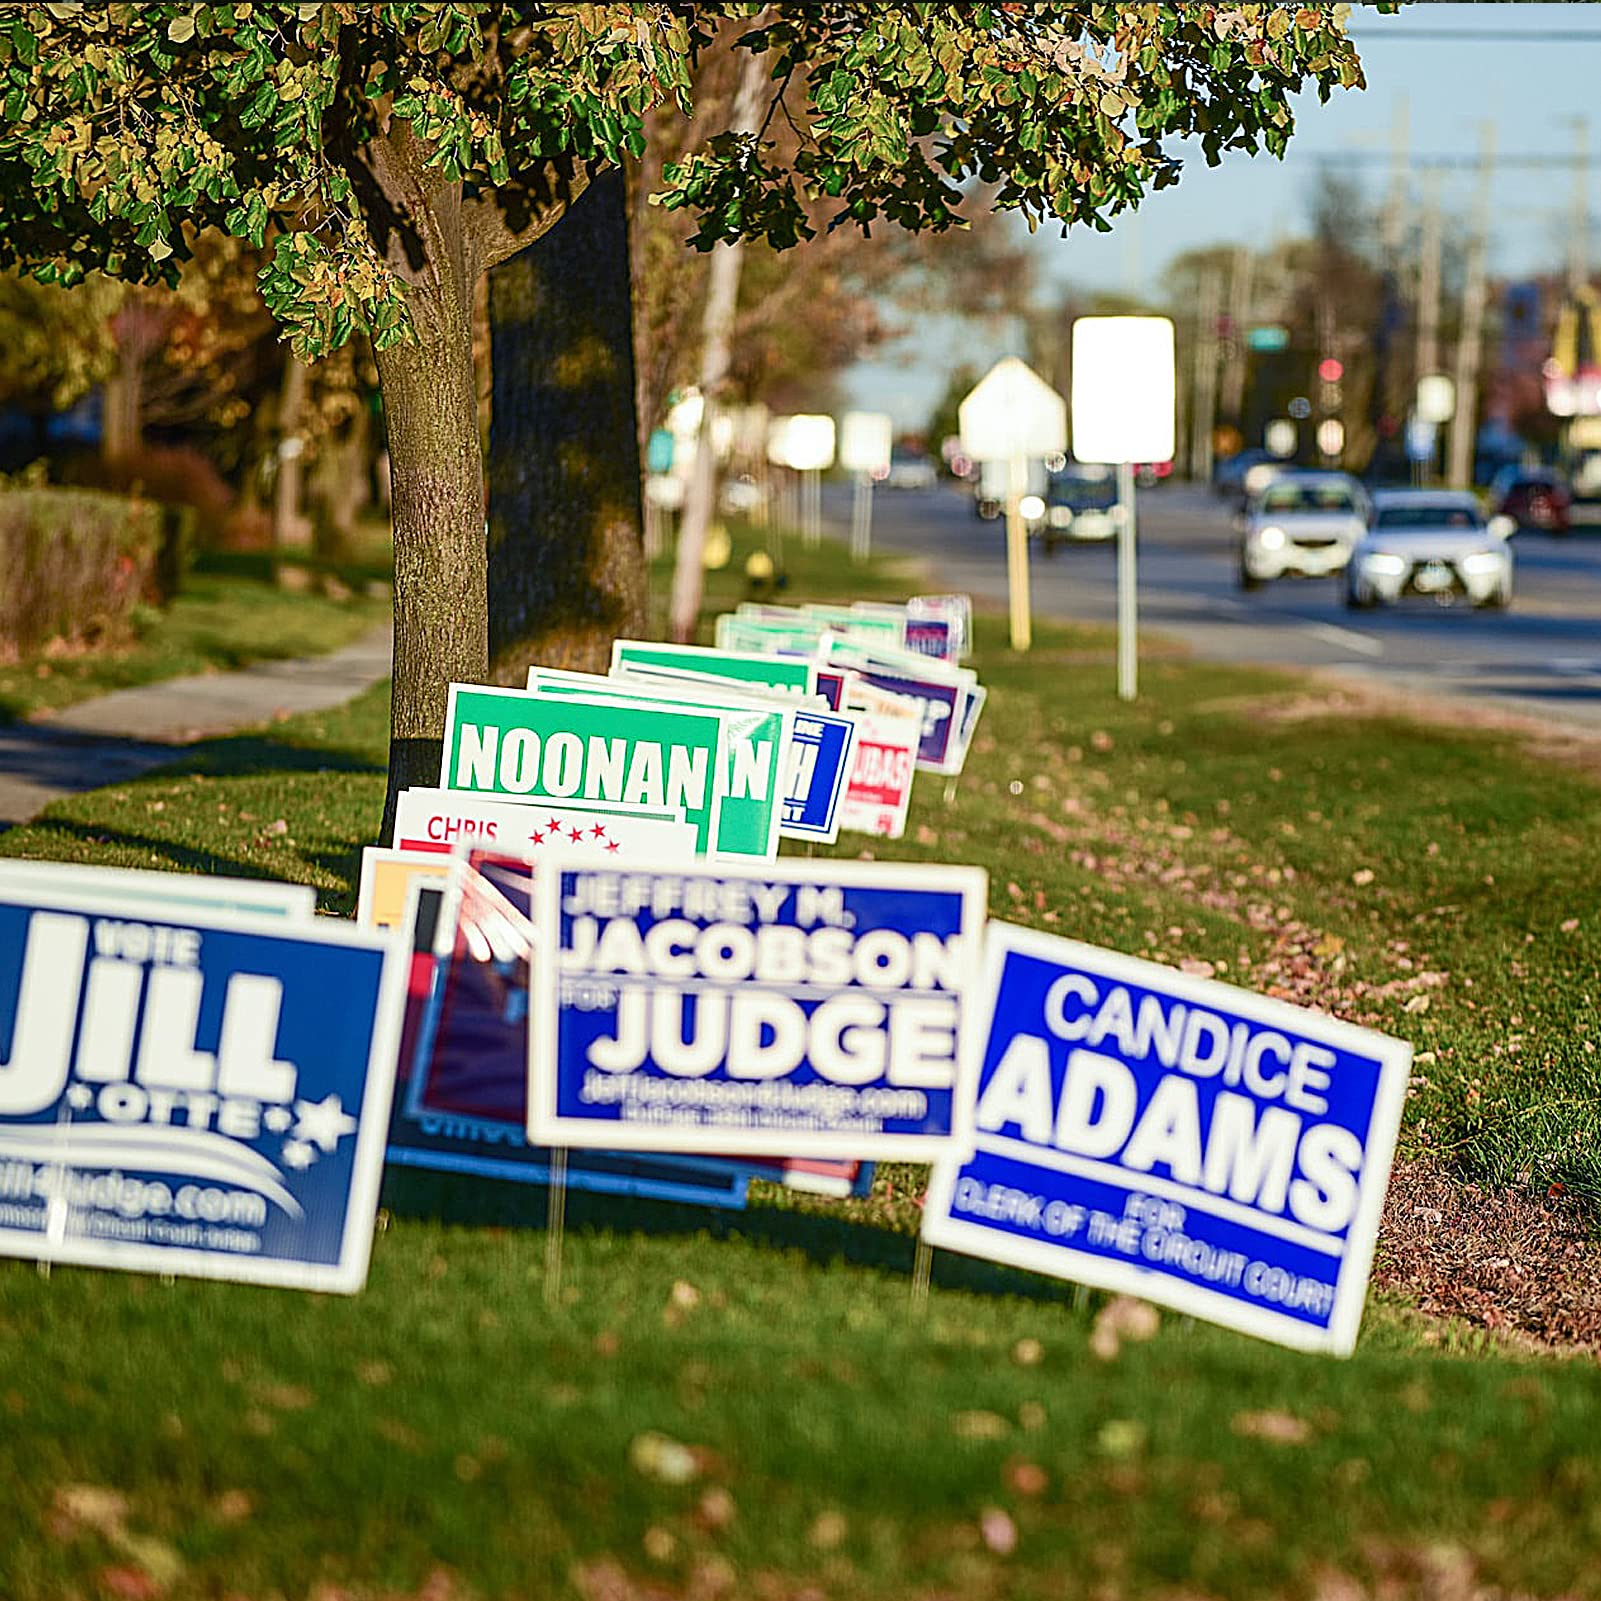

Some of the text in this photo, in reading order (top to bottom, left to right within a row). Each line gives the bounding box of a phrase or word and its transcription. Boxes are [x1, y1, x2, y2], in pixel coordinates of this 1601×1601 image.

[456, 723, 710, 810] NOONAN
[427, 816, 499, 841] CHRIS
[562, 873, 857, 929] JEFFREY M.
[94, 919, 203, 966] VOTE
[559, 914, 962, 990] JACOBSON
[0, 910, 298, 1116] JILL
[587, 983, 957, 1088] JUDGE
[1044, 973, 1337, 1116] CANDICE
[98, 1081, 264, 1139] OTTE
[976, 1032, 1364, 1232] ADAMS
[954, 1177, 1336, 1319] CLERK OF THE CIRCUIT COURT
[1123, 1192, 1187, 1233] FOR
